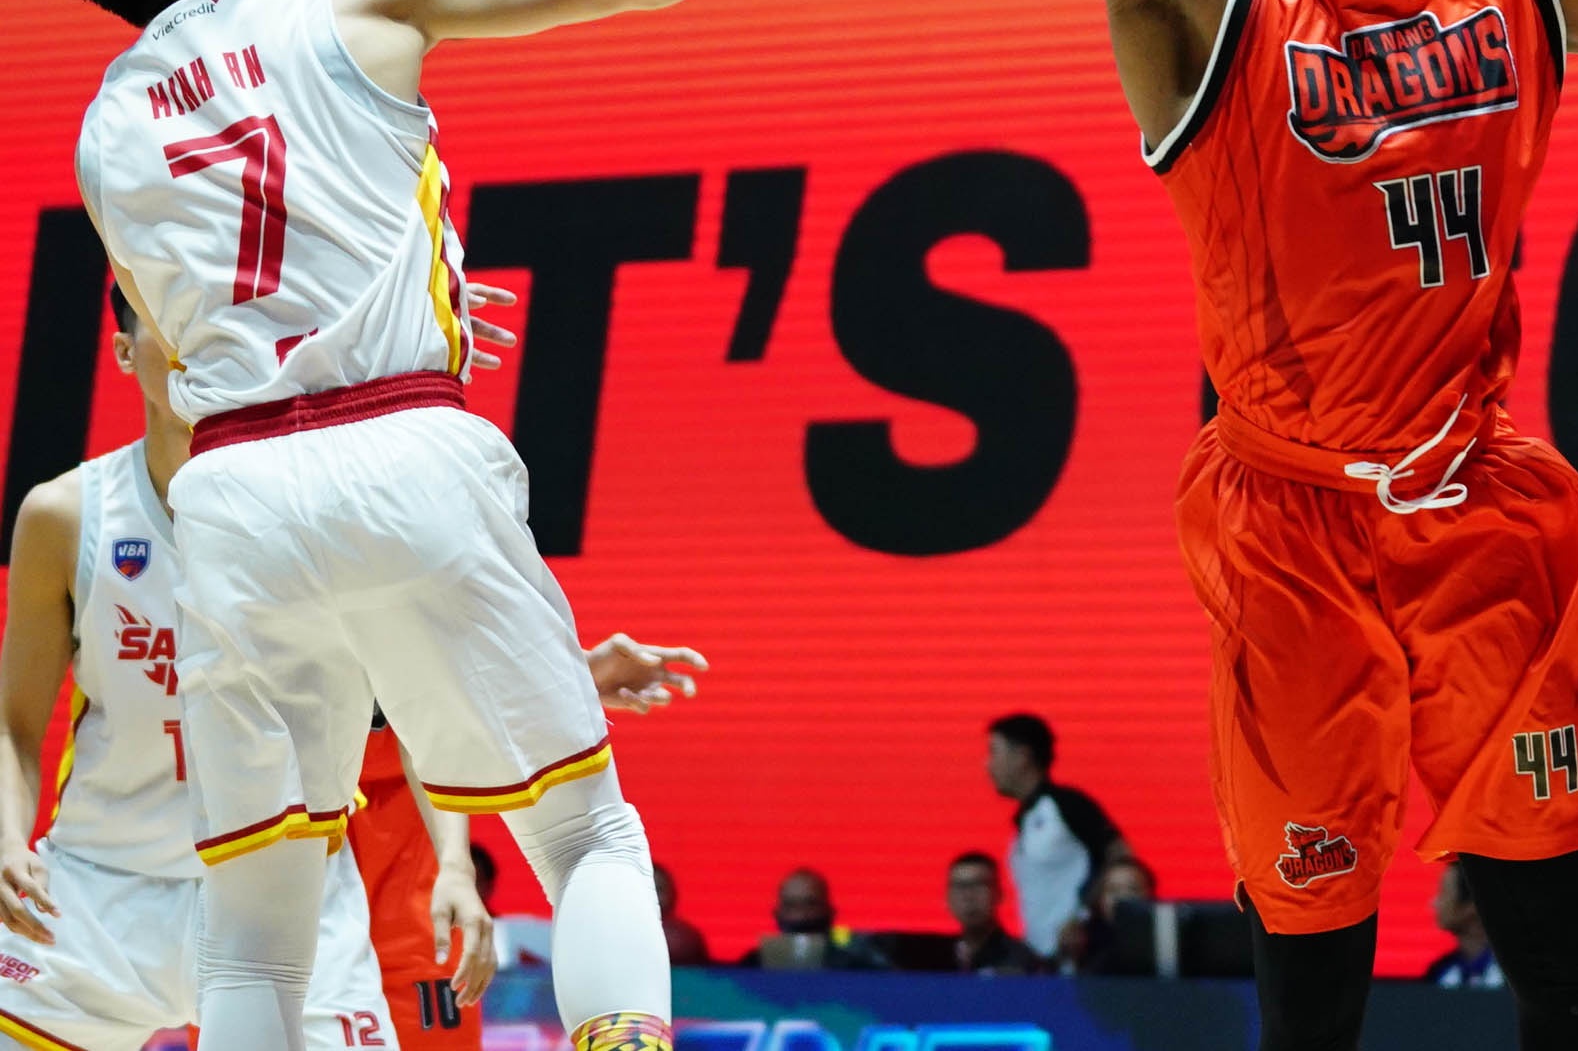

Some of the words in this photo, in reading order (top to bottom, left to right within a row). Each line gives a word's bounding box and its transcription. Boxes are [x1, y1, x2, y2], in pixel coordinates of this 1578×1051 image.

[152, 1, 218, 41] VietCredit
[1352, 37, 1378, 60] DA
[1382, 20, 1436, 54] NANG
[147, 56, 215, 119] MINH
[222, 44, 266, 89] AN
[1294, 14, 1514, 120] DRAGONS
[163, 113, 288, 306] 7
[1373, 165, 1490, 288] 44
[118, 544, 146, 557] VBA
[1283, 844, 1353, 878] DRAGONS
[0, 954, 40, 977] IGON
[334, 1011, 384, 1047] 12
